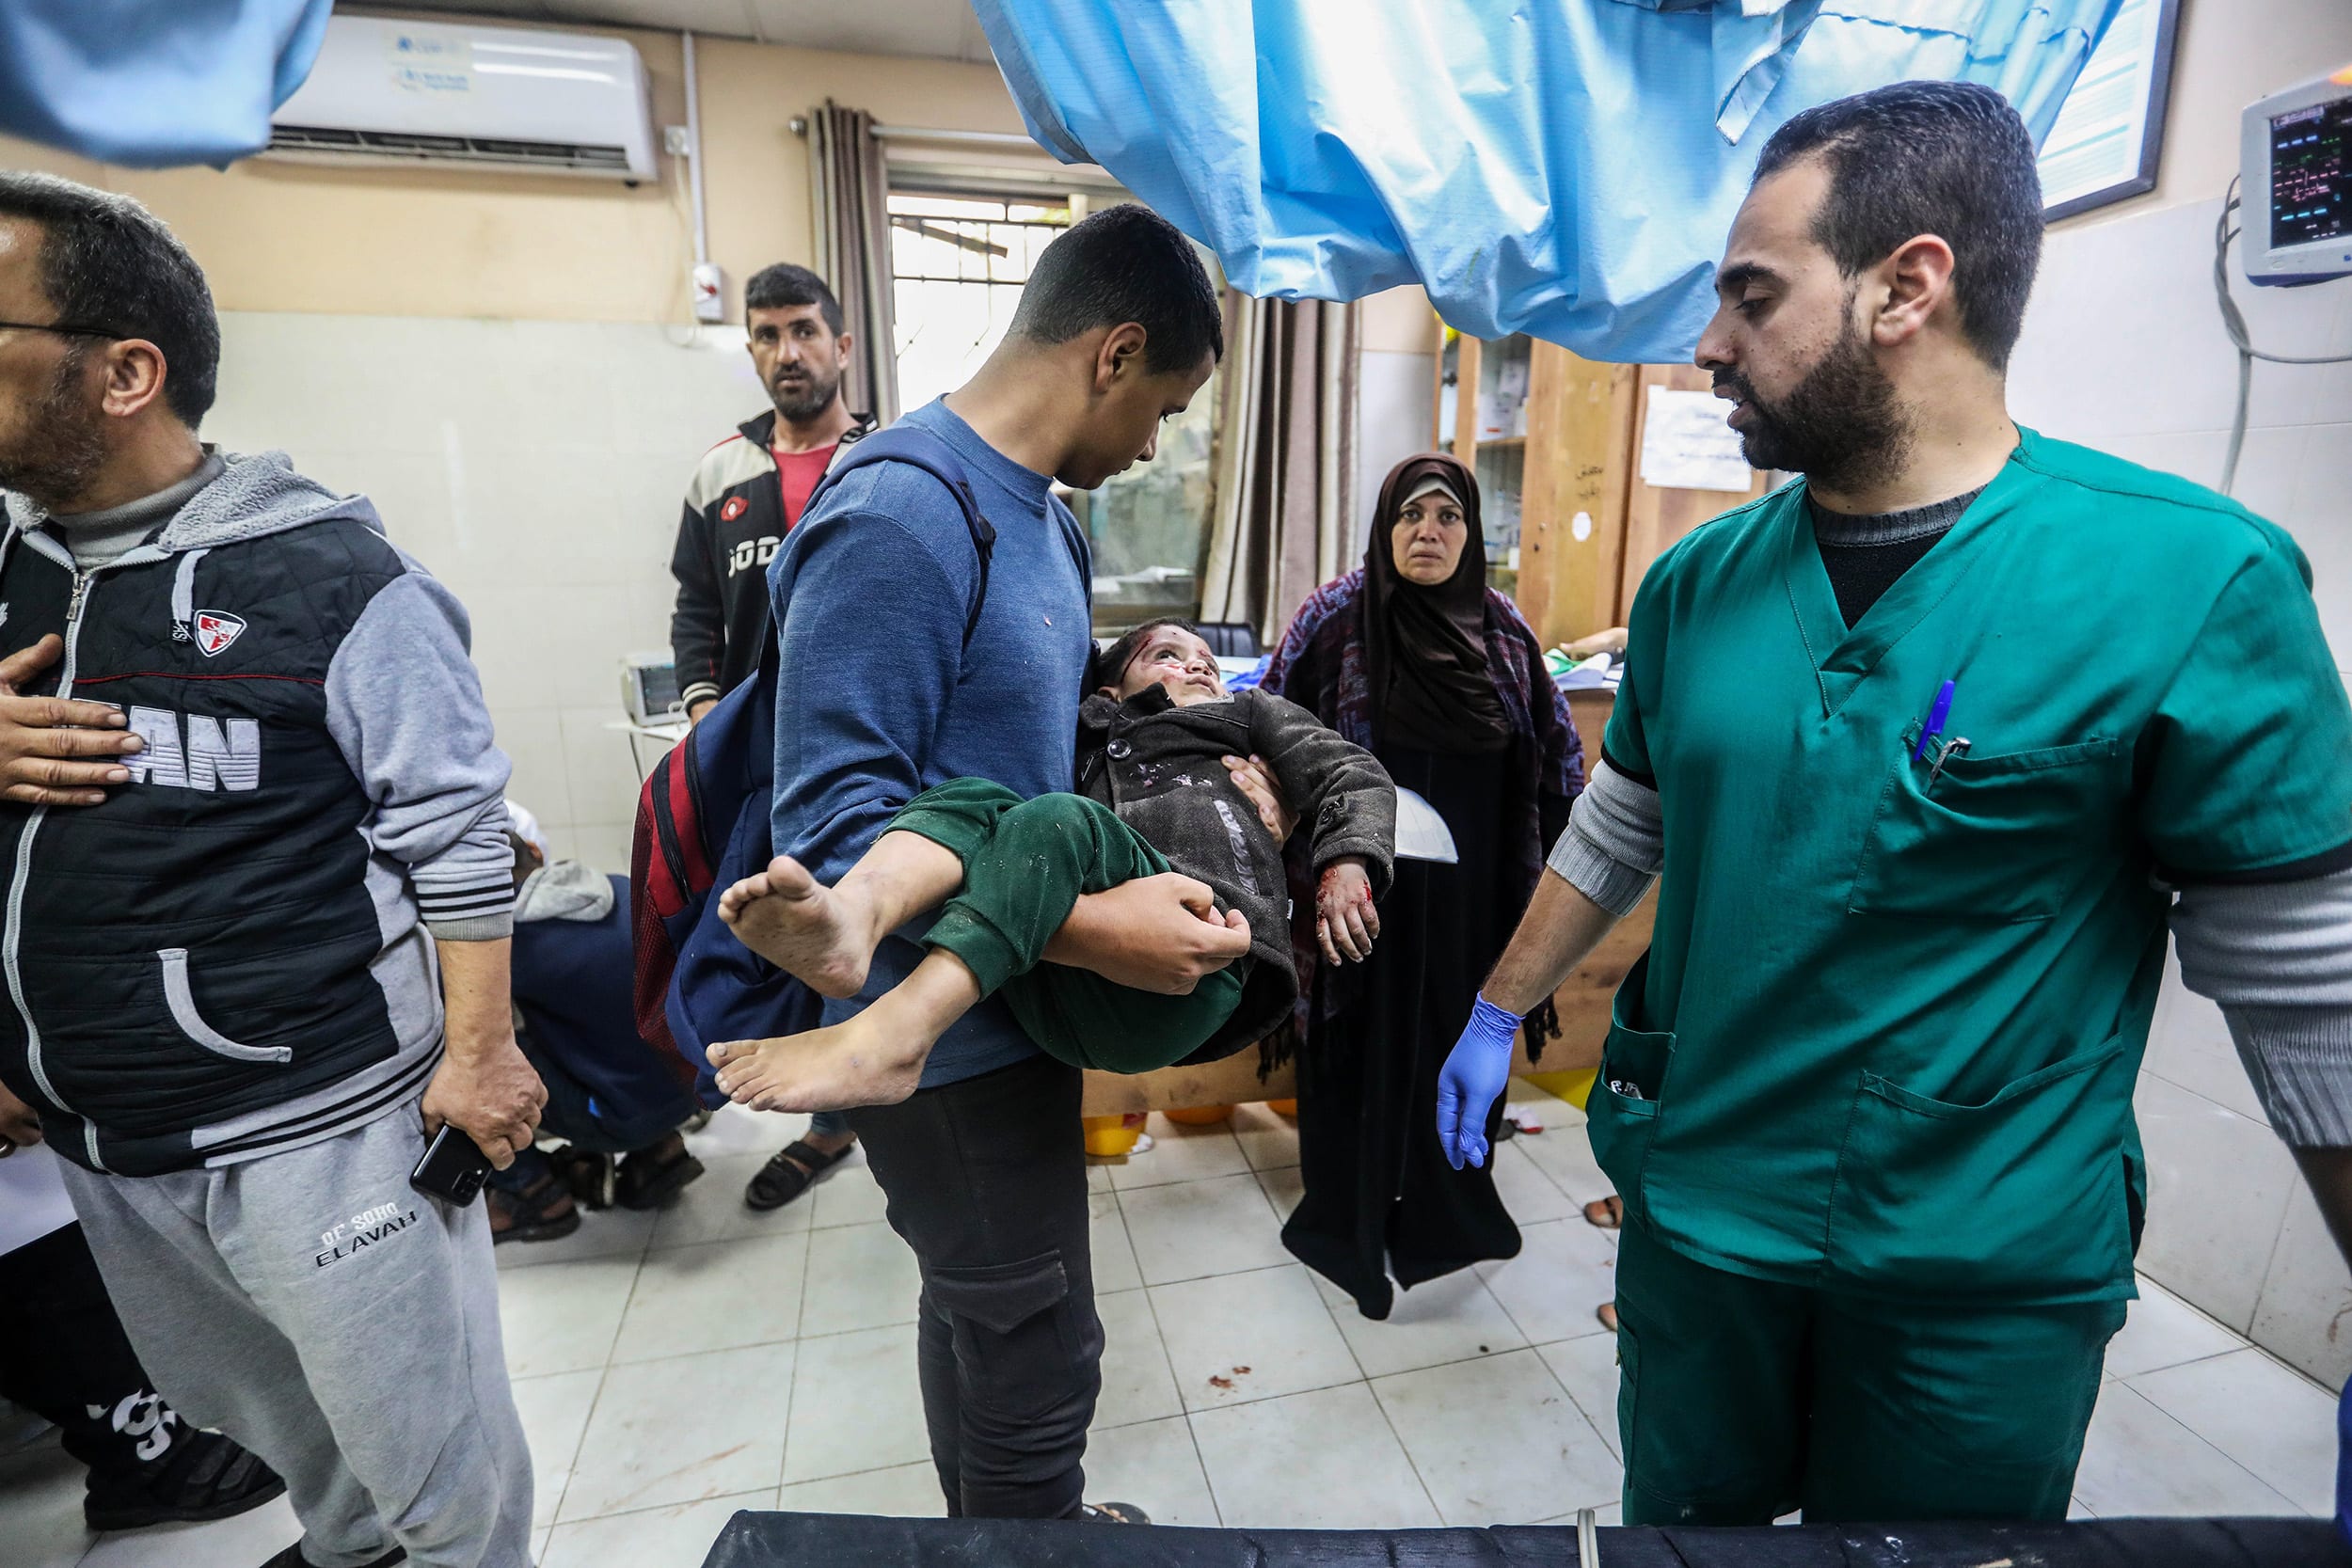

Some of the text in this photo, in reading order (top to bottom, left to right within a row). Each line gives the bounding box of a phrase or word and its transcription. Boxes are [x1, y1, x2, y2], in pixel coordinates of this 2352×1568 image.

[78, 698, 260, 791] AN
[316, 1211, 417, 1268] ELAVAH
[321, 1202, 399, 1245] OF SOHO
